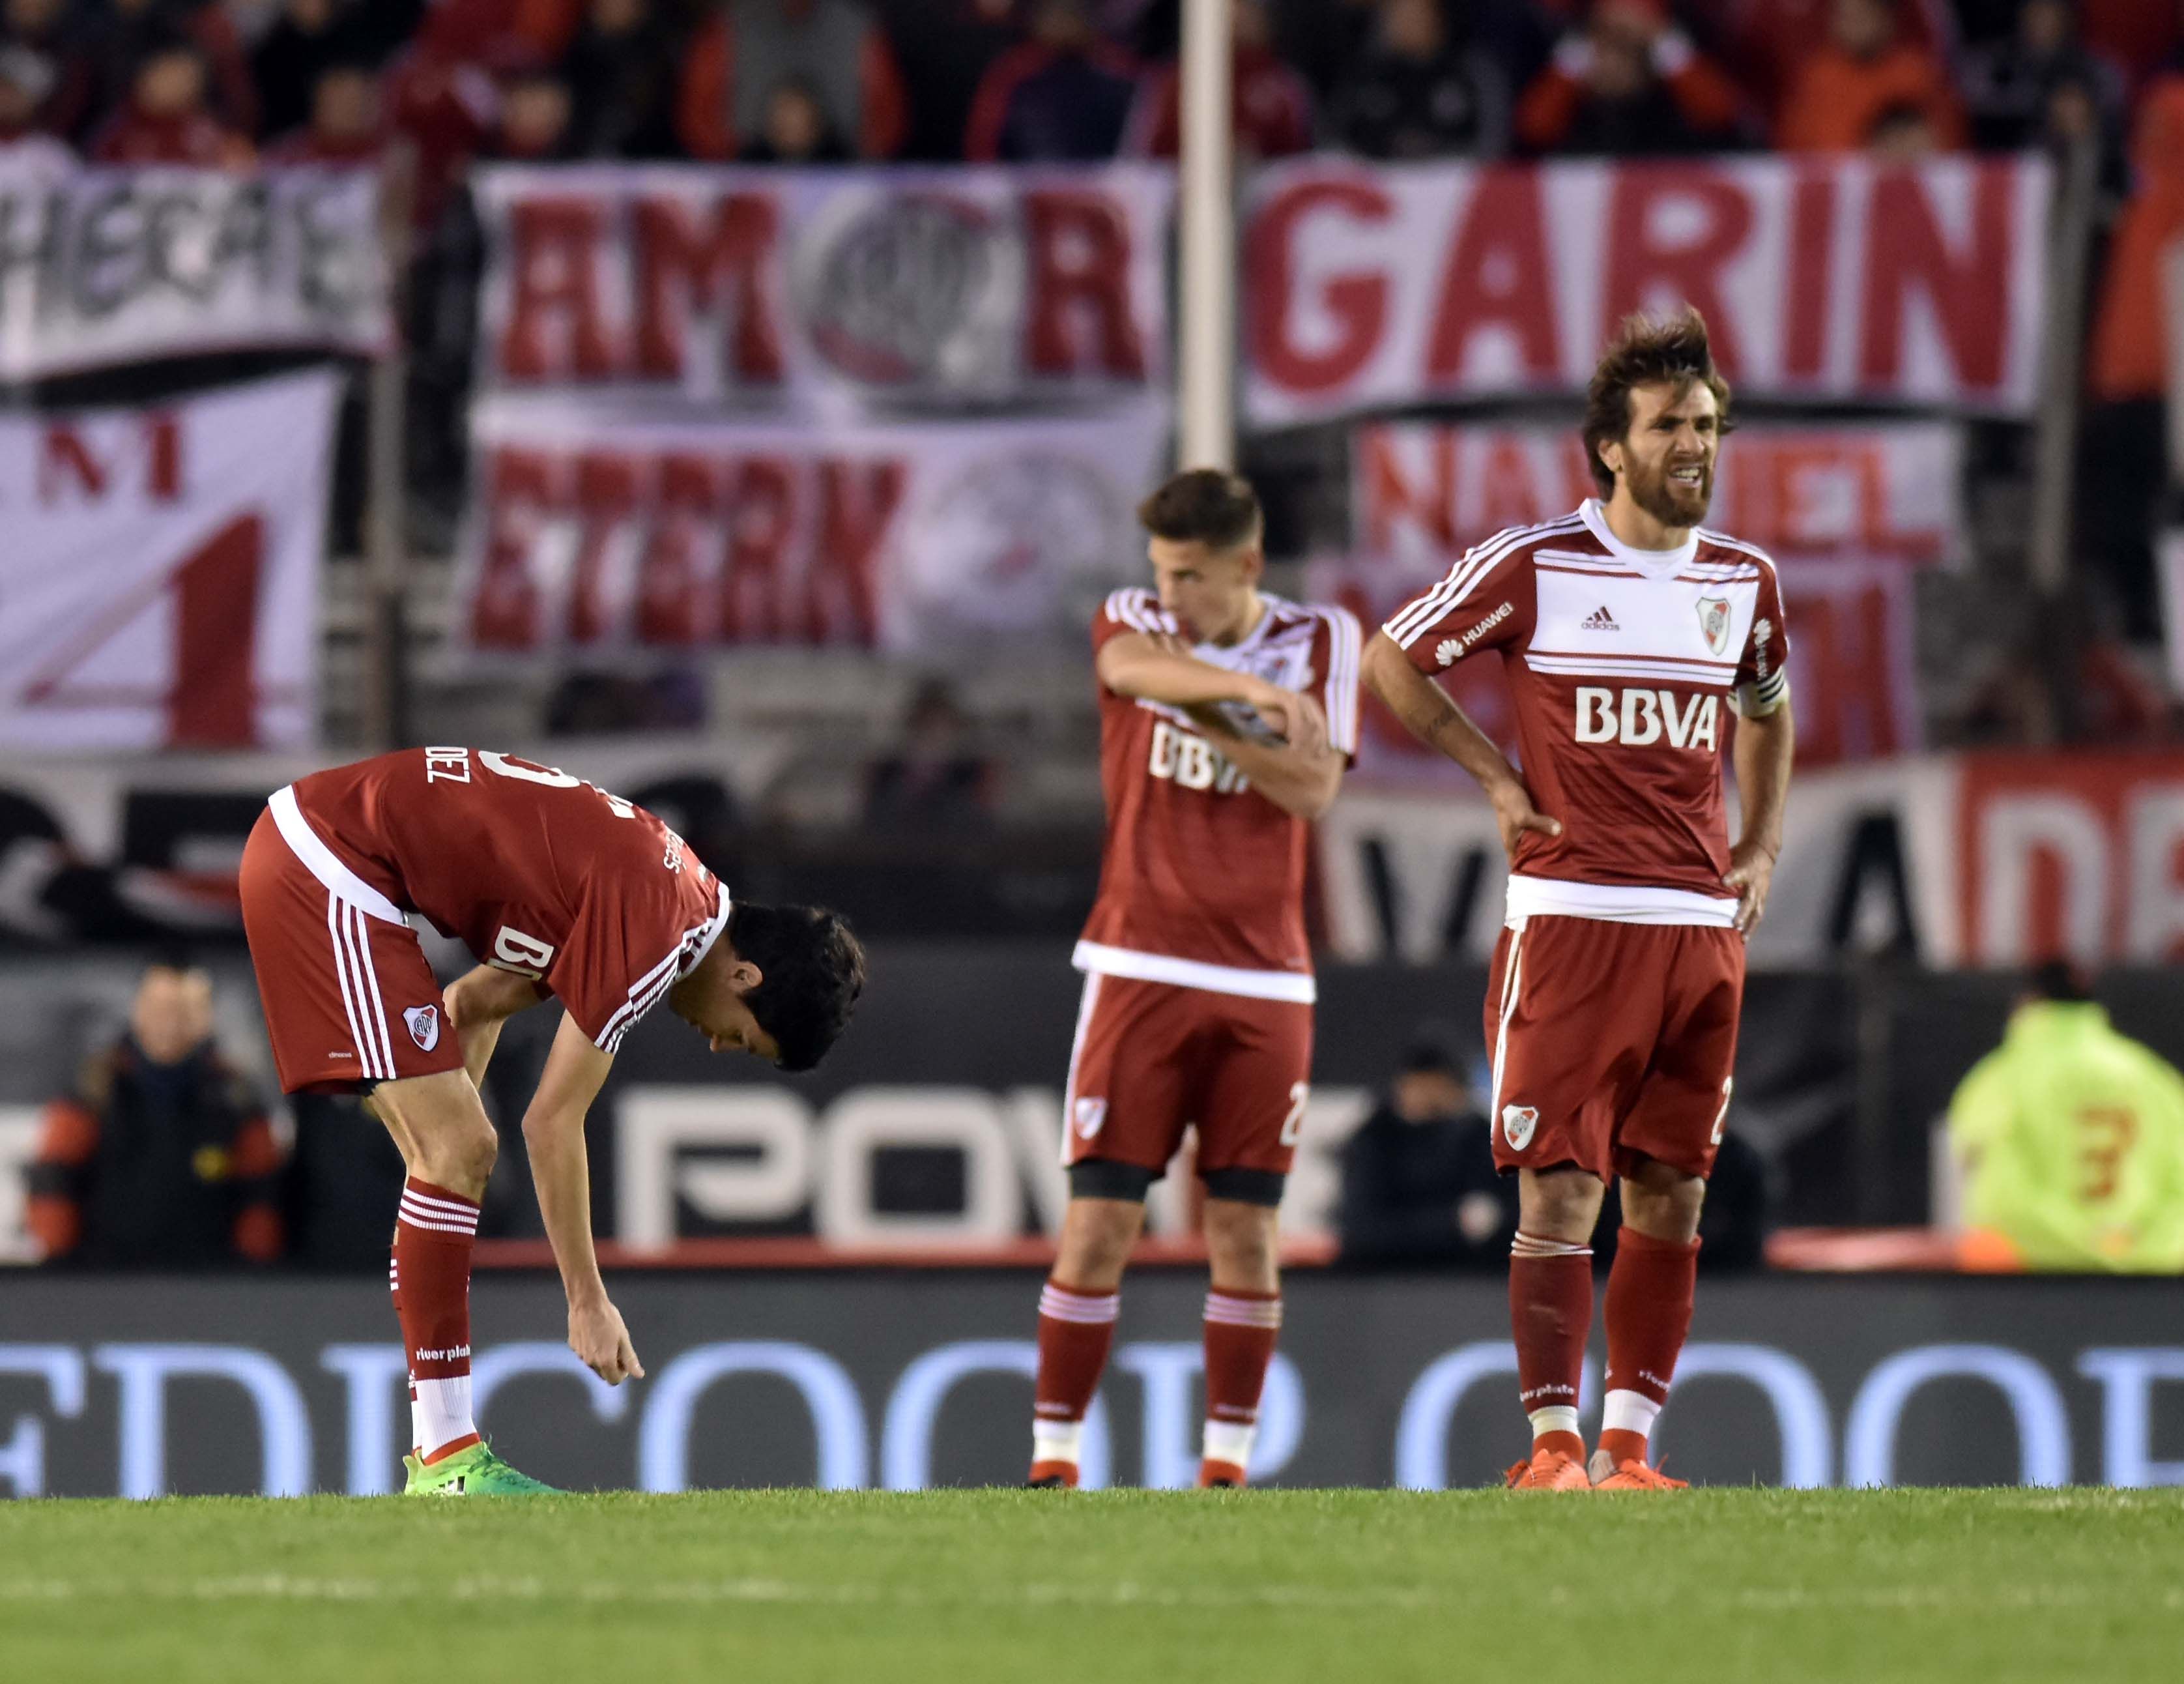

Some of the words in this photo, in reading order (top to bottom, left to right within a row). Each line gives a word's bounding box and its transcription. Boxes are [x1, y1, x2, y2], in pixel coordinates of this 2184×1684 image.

[1246, 164, 2017, 405] GARIN
[1462, 601, 1516, 646] HUAWEI
[1581, 620, 1620, 632] adidas
[1575, 686, 1718, 753] BBVA
[425, 746, 470, 784] DEZ
[1149, 721, 1250, 794] BBV
[416, 1347, 445, 1361] river
